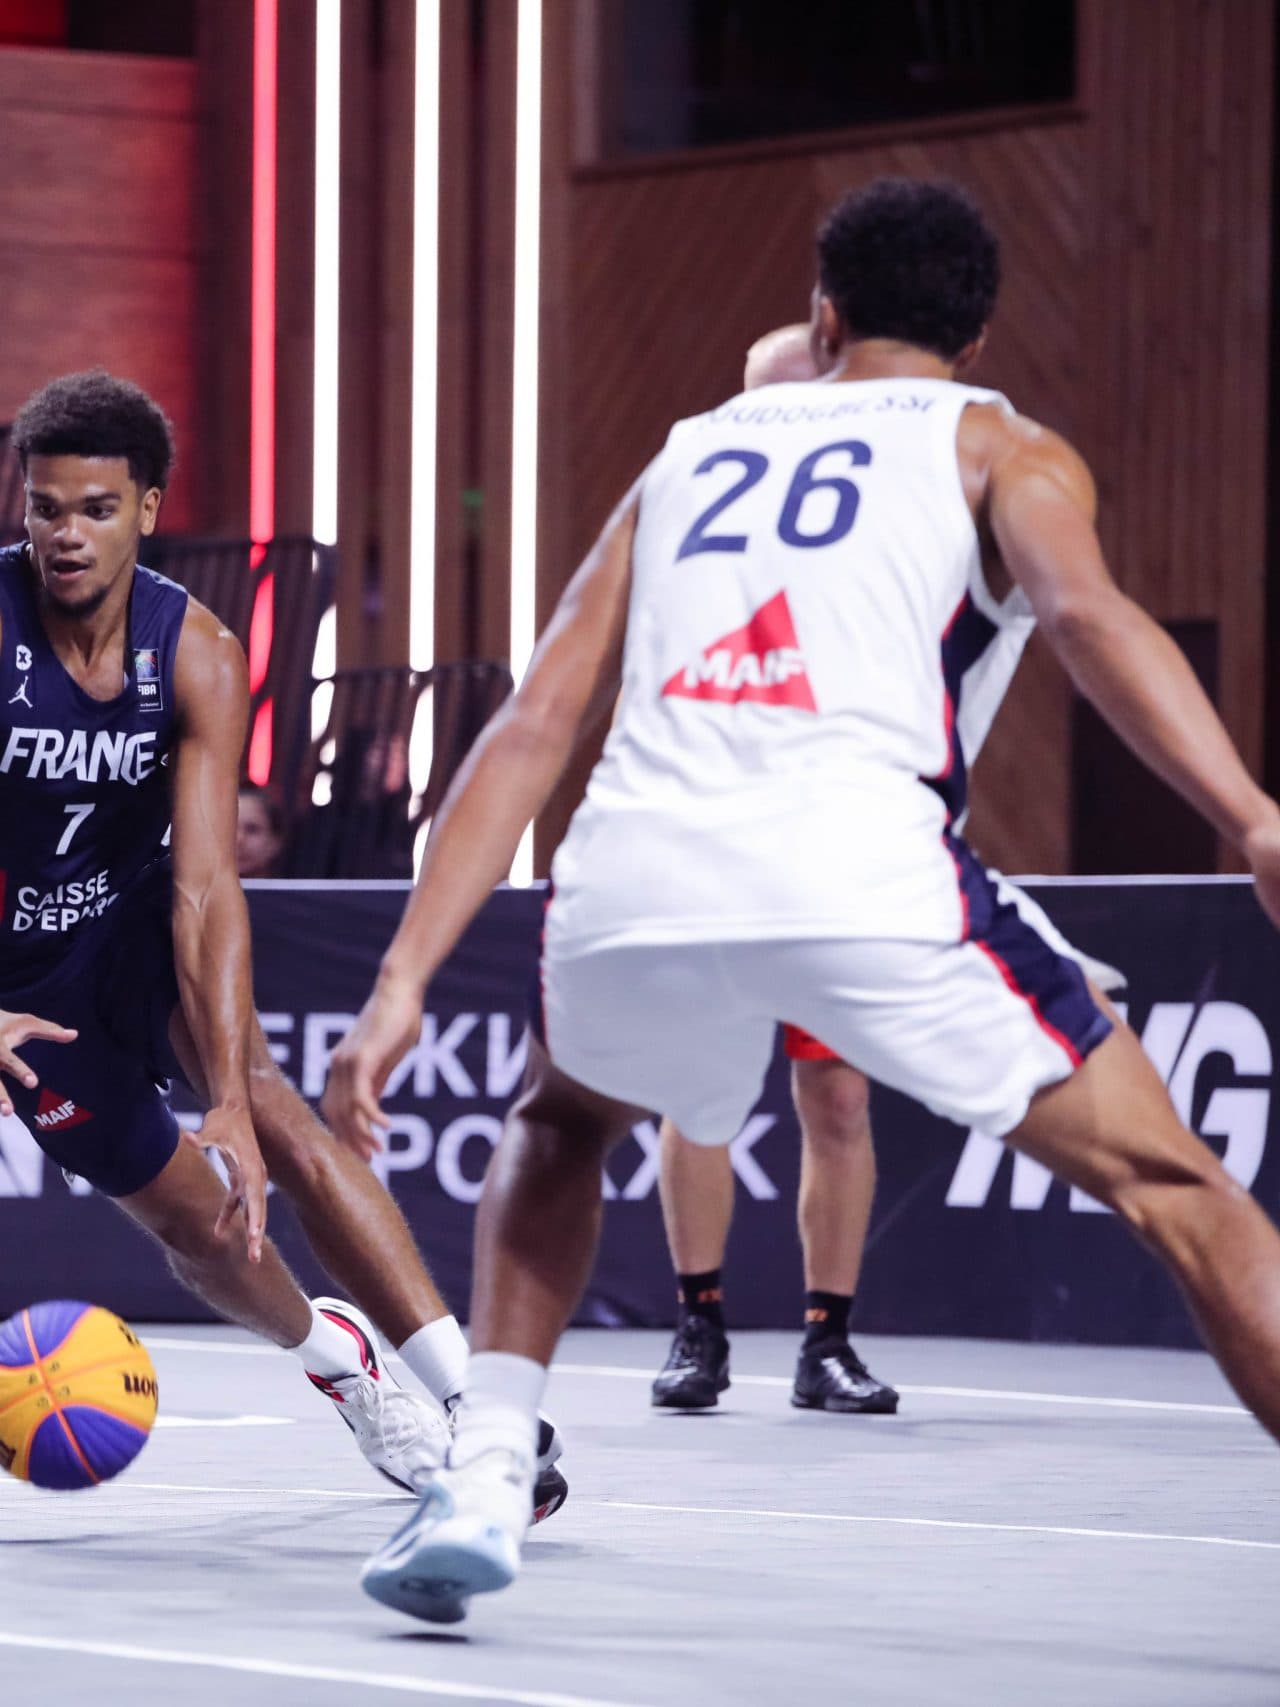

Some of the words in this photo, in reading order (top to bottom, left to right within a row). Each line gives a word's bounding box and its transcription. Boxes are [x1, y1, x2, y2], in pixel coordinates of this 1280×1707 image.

[675, 440, 872, 563] 26
[137, 684, 157, 695] FIBA
[55, 803, 96, 855] 7
[18, 870, 109, 911] CAISSE
[34, 1100, 76, 1127] MAIF
